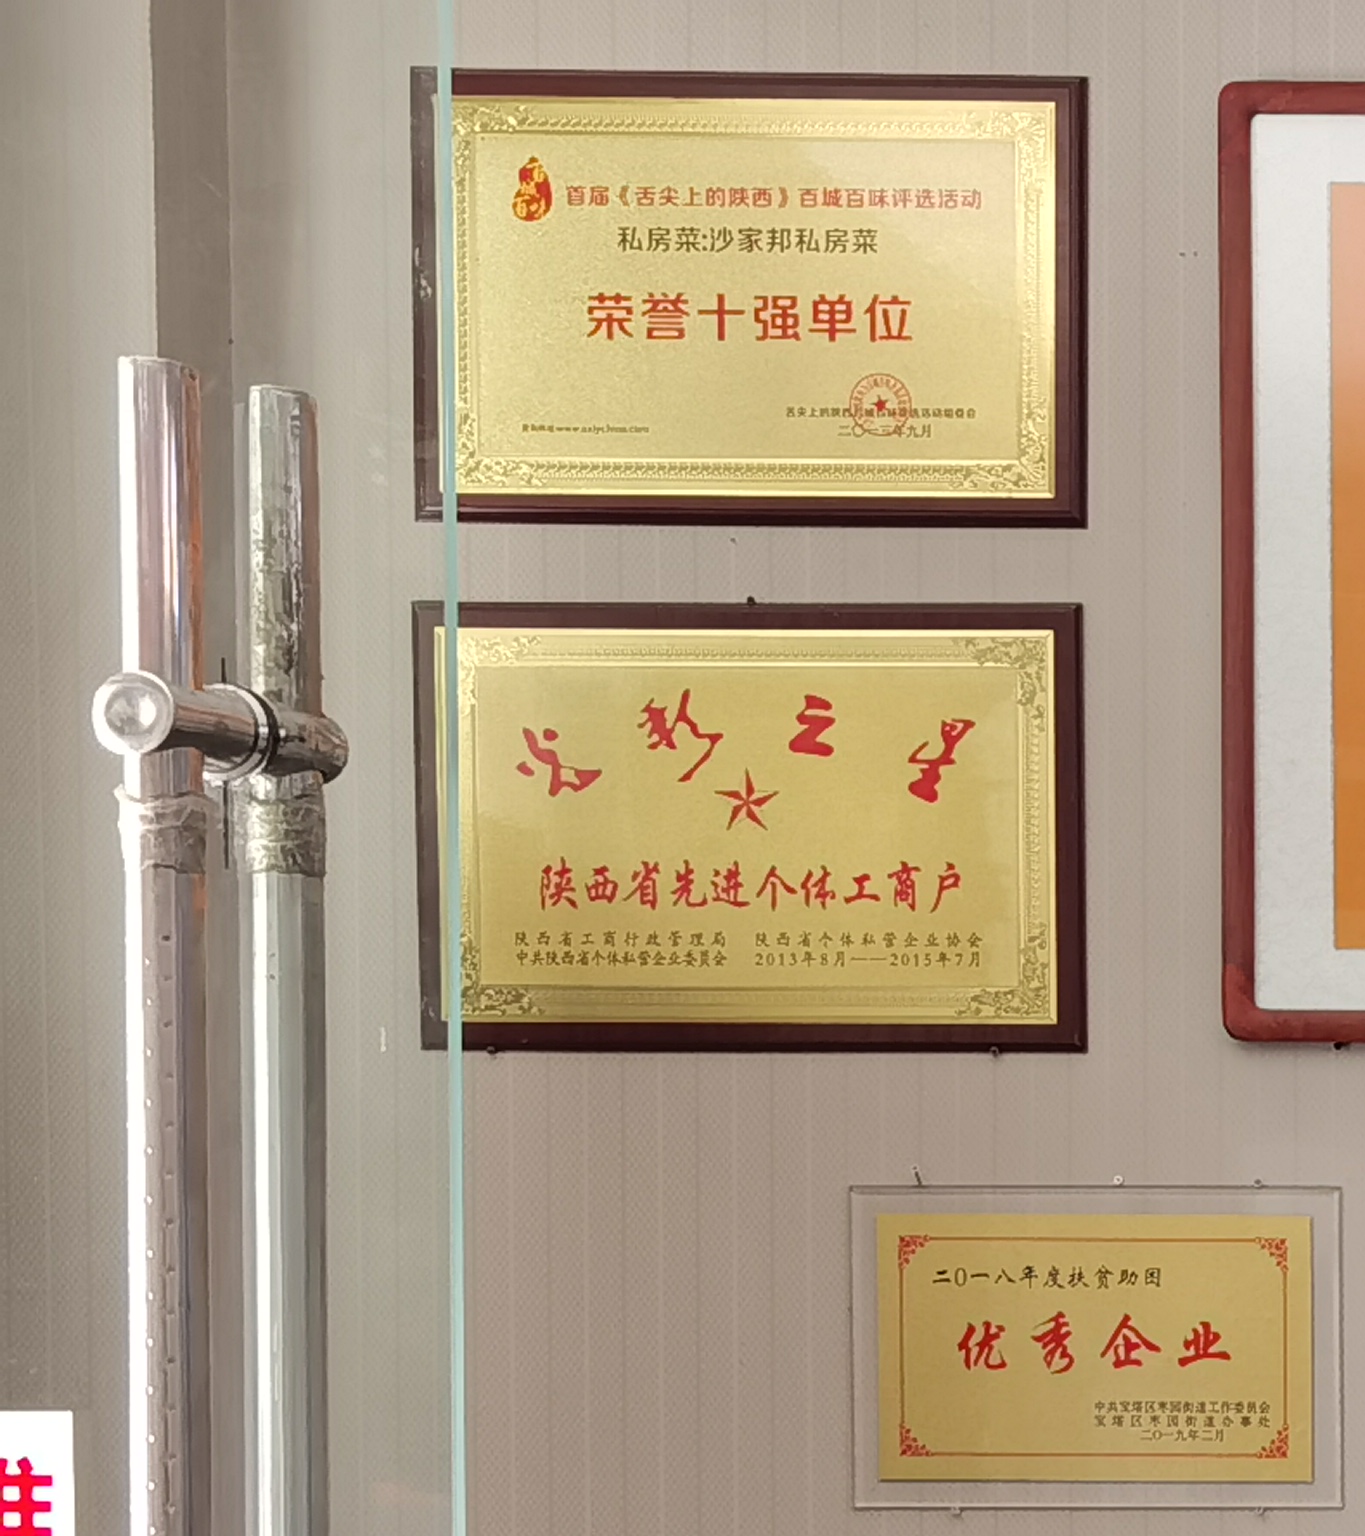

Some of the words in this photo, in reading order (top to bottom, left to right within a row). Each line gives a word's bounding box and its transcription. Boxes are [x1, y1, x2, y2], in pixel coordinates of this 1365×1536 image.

[586, 292, 913, 342] 荣誉十强单位
[539, 857, 964, 913] 陕西省先进个体工商户
[957, 1311, 1232, 1374] 优秀企业
